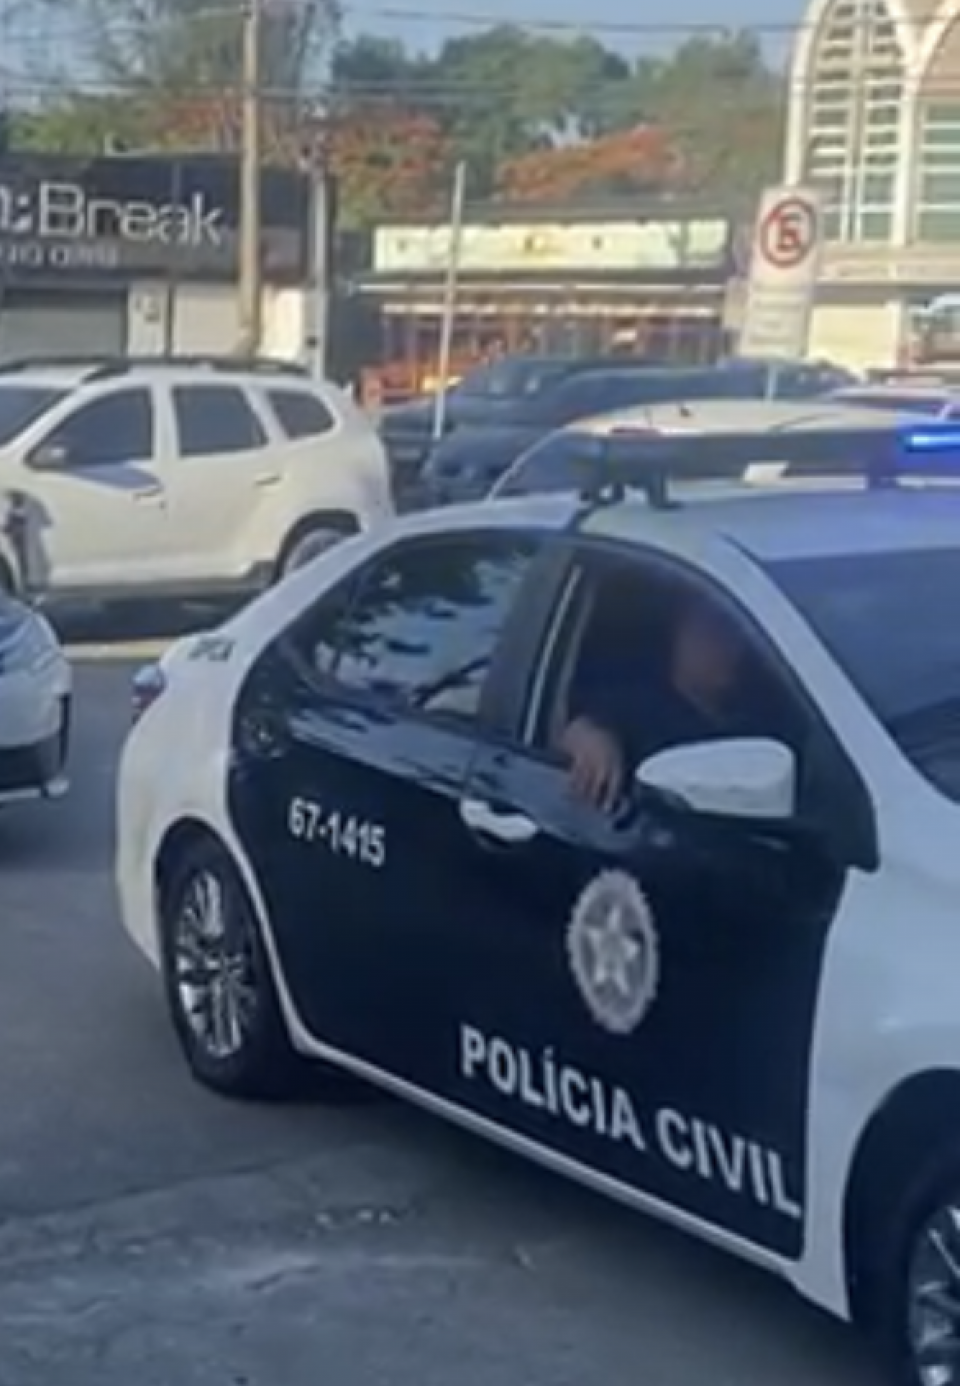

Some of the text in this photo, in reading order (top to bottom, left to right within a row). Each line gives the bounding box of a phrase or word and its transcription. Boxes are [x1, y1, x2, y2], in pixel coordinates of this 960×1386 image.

[288, 795, 386, 867] 67-1415
[460, 1023, 802, 1218] POLÍCIA CIVIL
